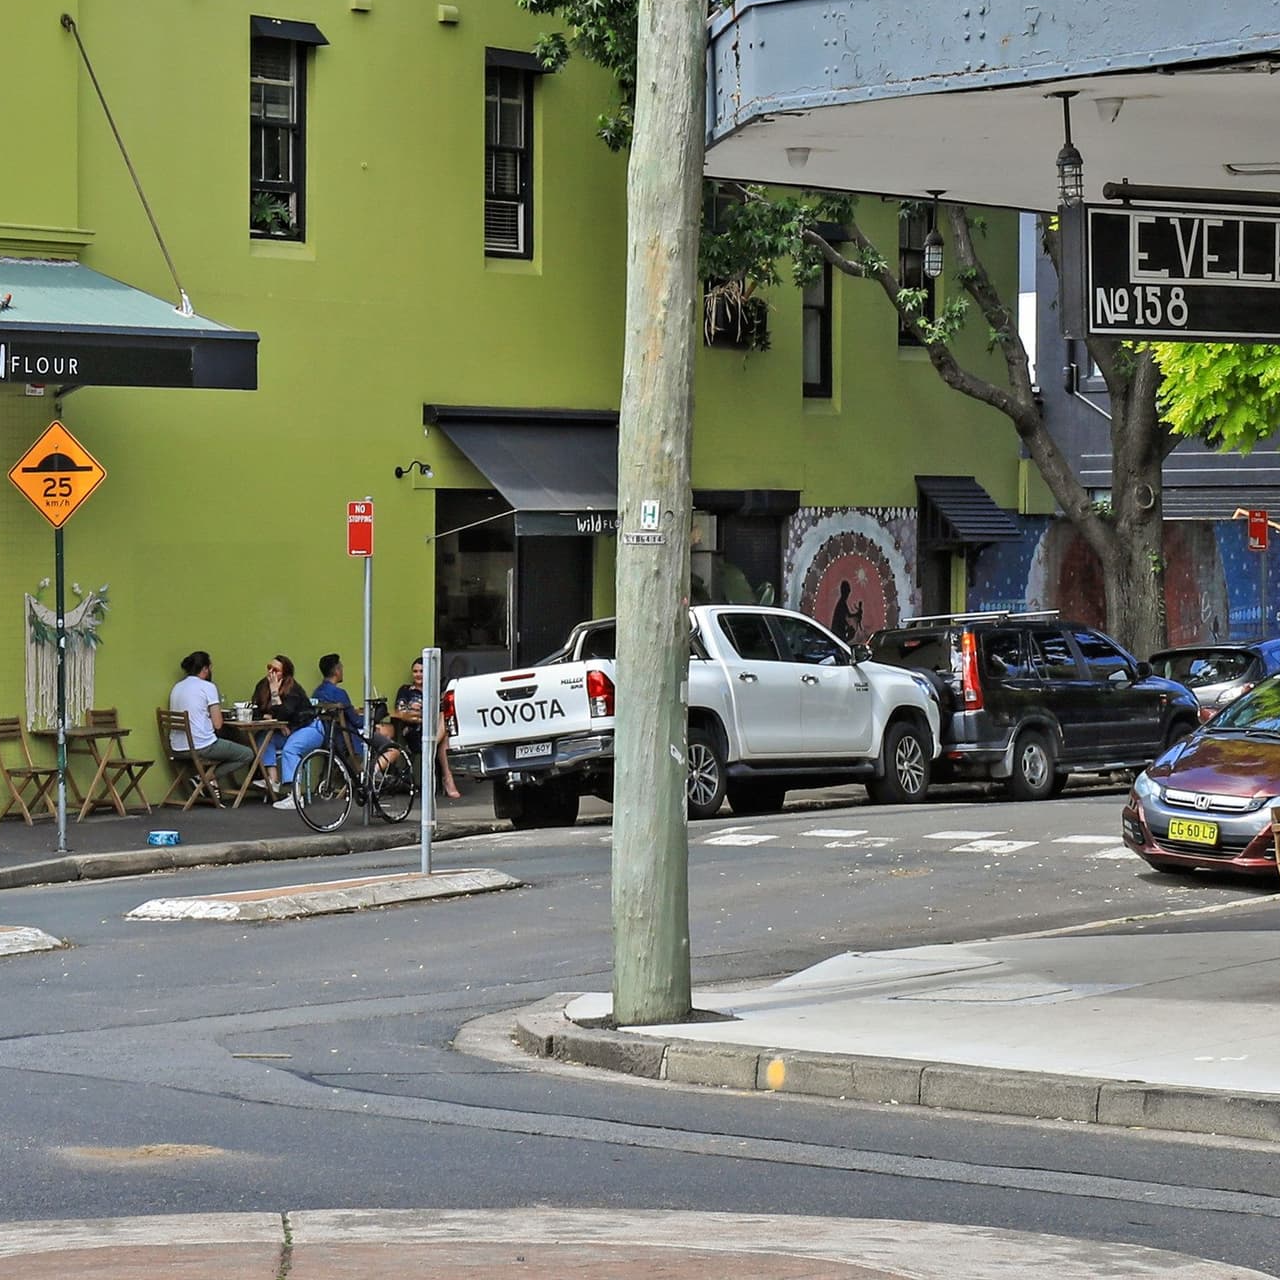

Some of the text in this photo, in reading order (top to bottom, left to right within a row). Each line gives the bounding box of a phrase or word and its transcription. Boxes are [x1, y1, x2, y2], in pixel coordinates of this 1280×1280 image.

[43, 477, 73, 498] 25
[46, 499, 70, 507] km/h
[355, 505, 366, 514] NO
[643, 505, 656, 523] H
[477, 699, 566, 727] TOYOTA
